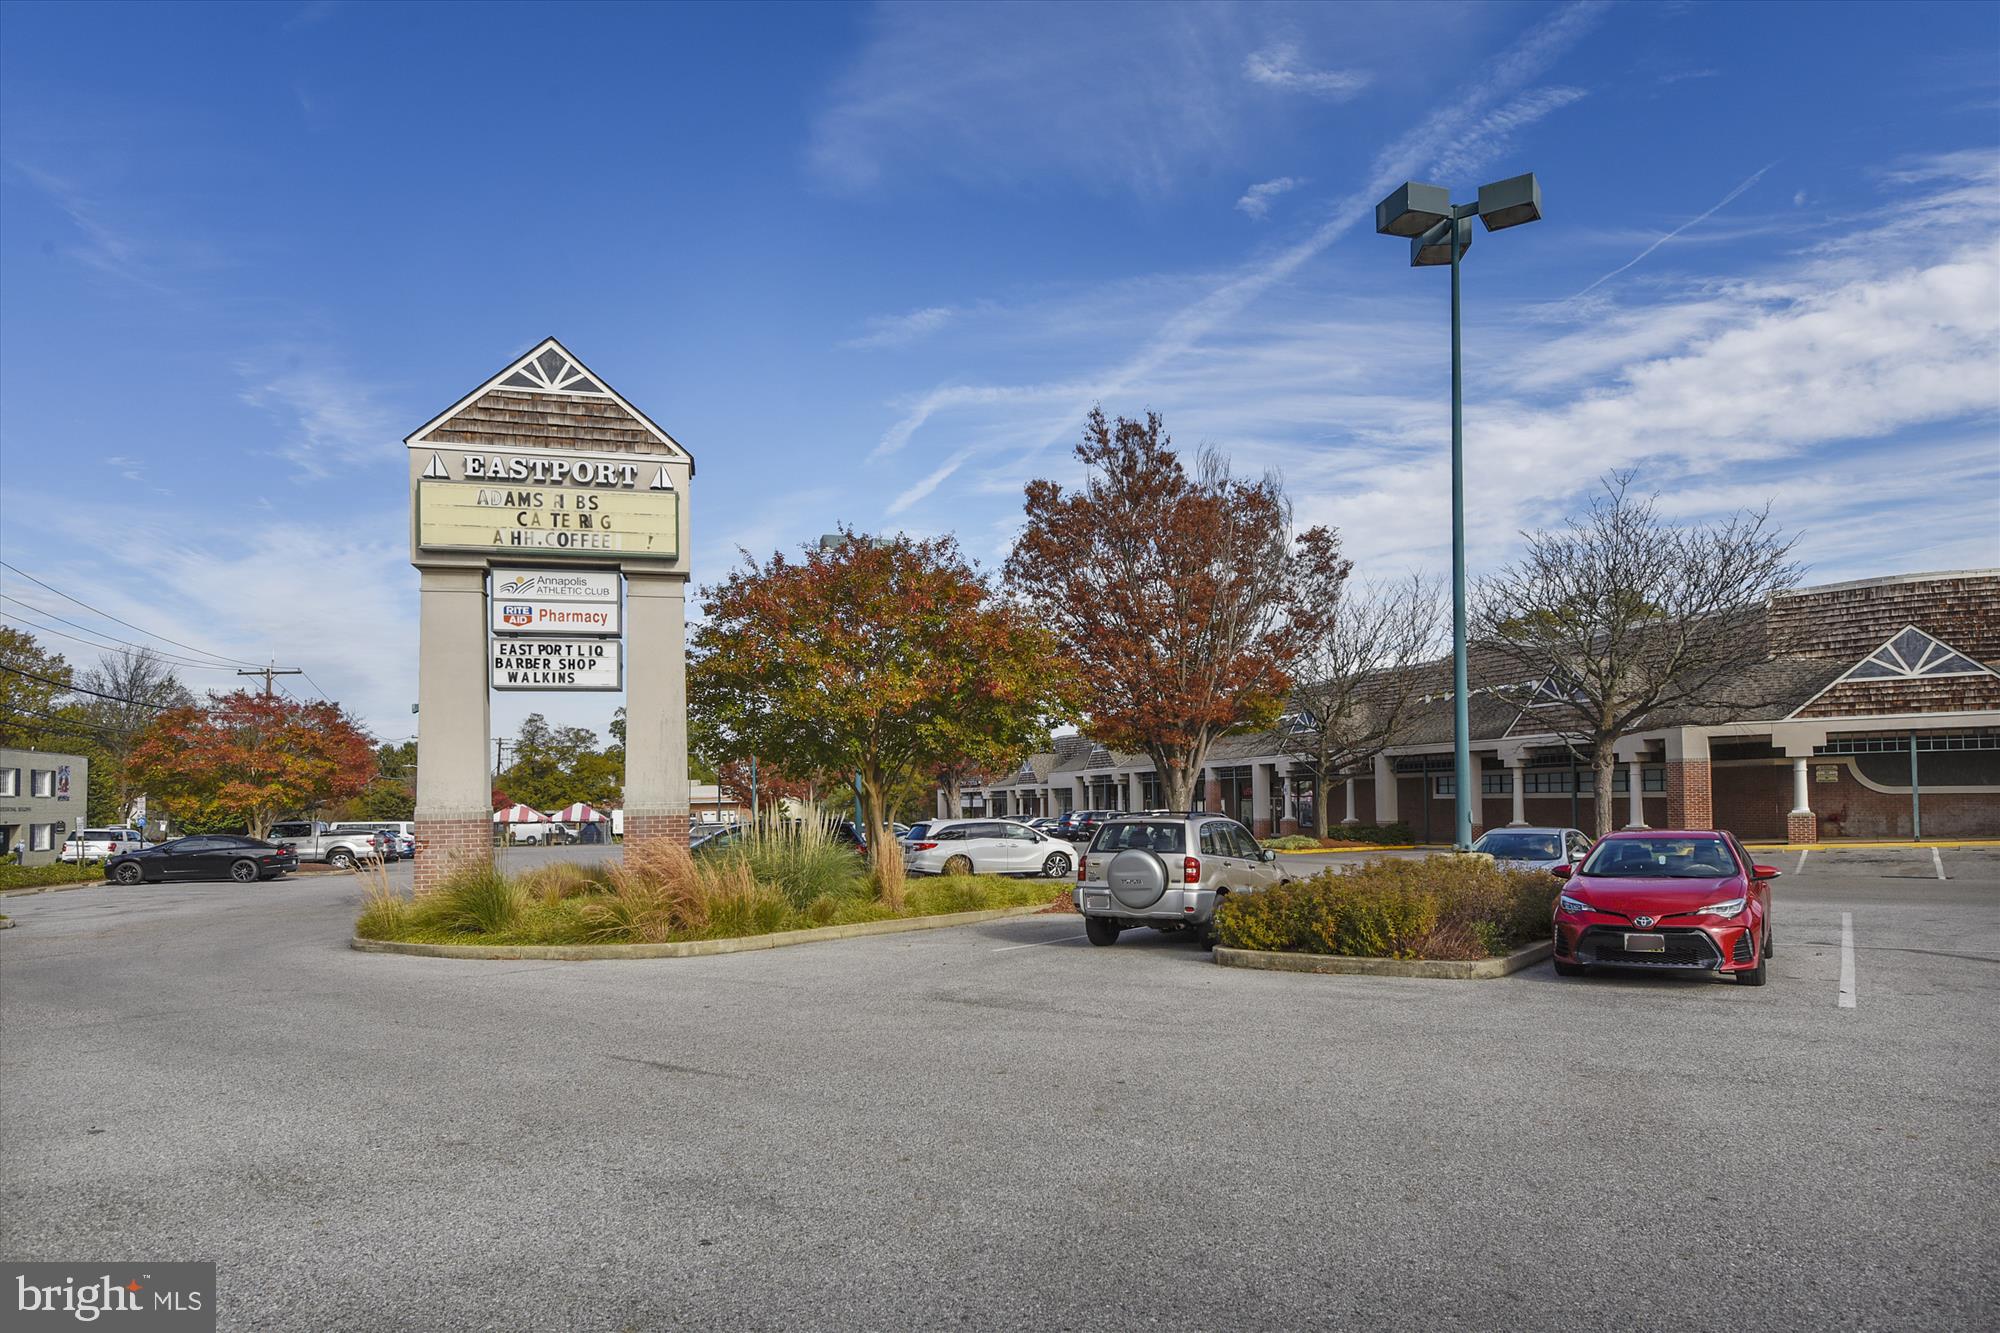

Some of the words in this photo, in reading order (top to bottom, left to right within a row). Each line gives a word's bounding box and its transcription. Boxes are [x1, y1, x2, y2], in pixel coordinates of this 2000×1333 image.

[463, 455, 638, 486] EASTPORT
[477, 489, 543, 508] ADAMS
[536, 575, 587, 586] Annapolis
[536, 586, 582, 595] ATHLETIC
[584, 587, 610, 596] CLUB
[506, 606, 530, 615] RITE
[509, 615, 528, 624] AID
[539, 608, 608, 626] Pharmacy
[577, 645, 604, 657] LIQ
[495, 658, 551, 670] BARBER
[559, 658, 597, 671] SHOP
[507, 671, 576, 684] WALKINS
